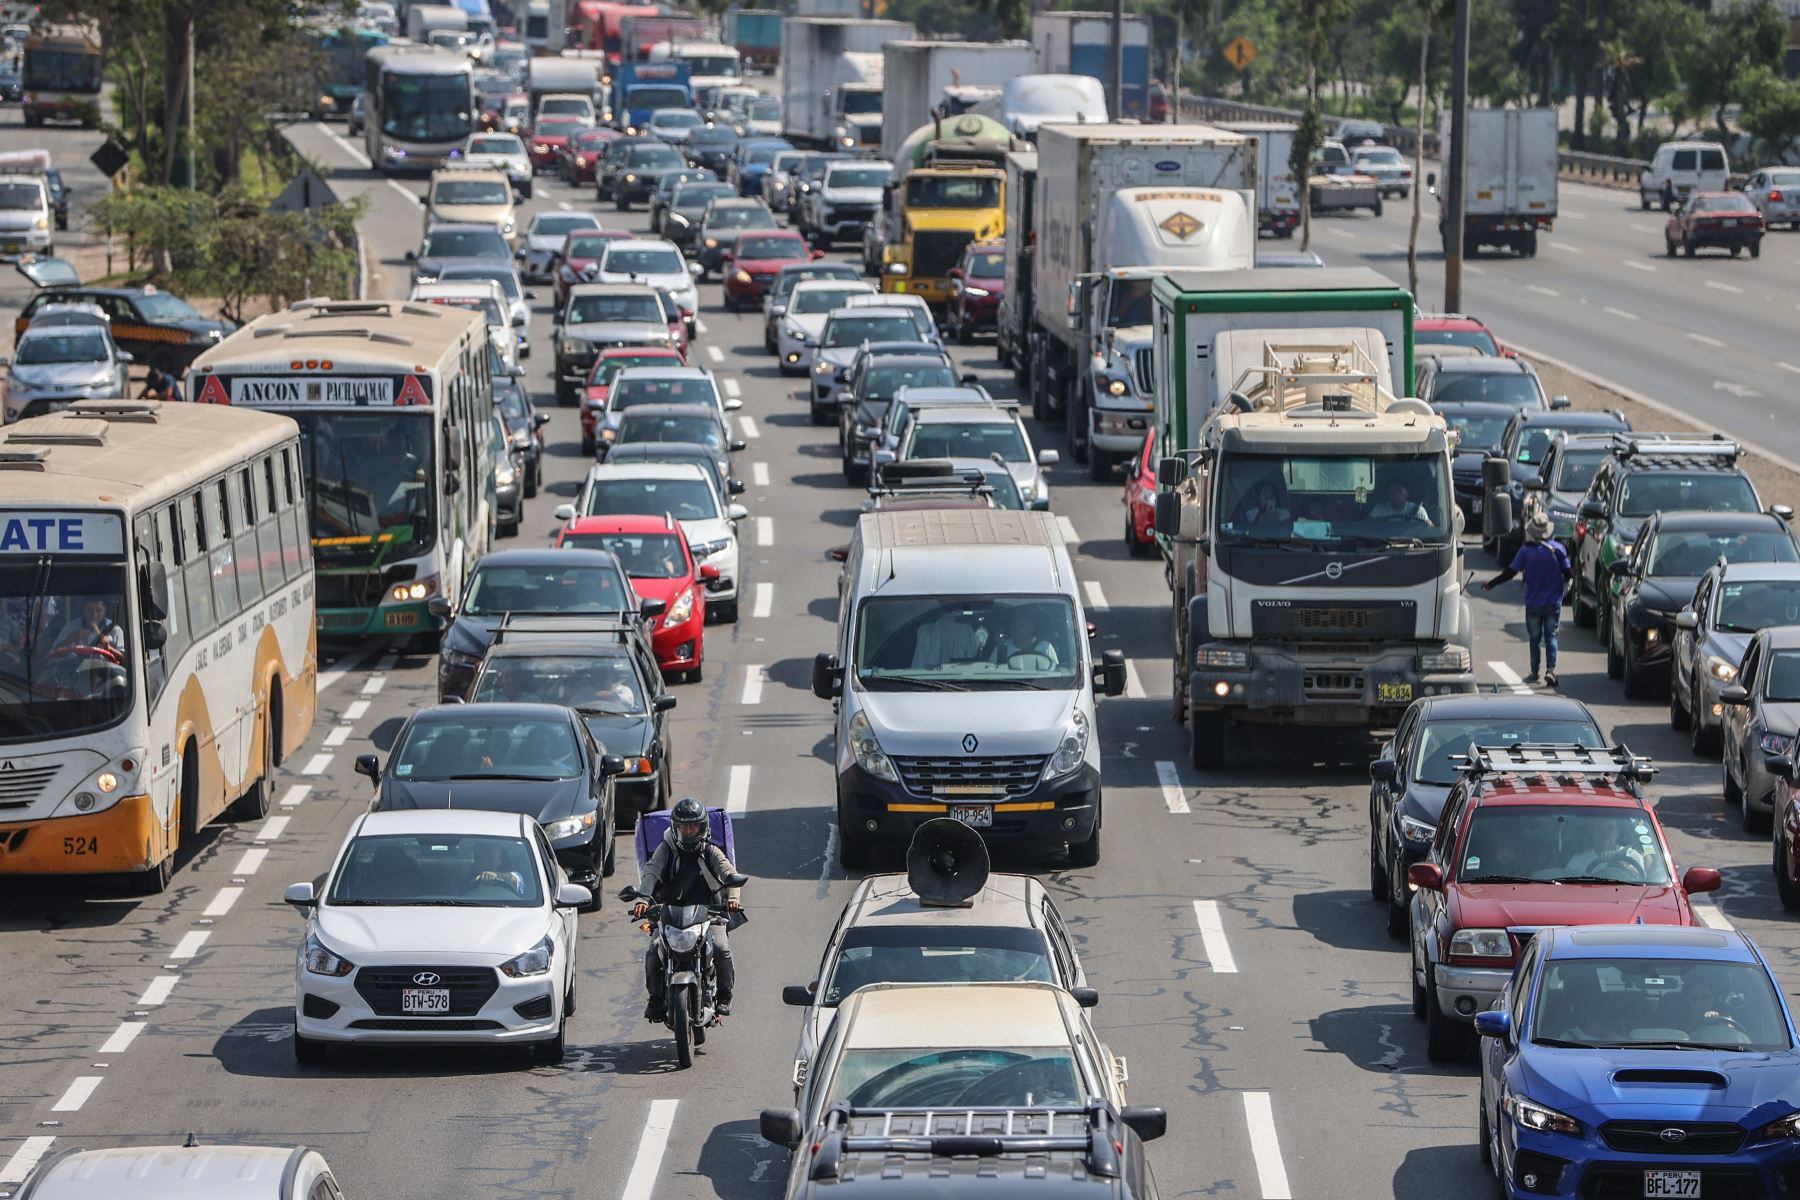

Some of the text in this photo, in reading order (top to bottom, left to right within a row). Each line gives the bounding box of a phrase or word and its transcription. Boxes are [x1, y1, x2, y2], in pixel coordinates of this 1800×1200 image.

[240, 382, 300, 401] ANCON
[327, 382, 389, 401] PACHACAMAC
[0, 519, 84, 550] ATE
[64, 837, 98, 855] 524
[404, 995, 448, 1009] BTW-578
[1647, 1179, 1699, 1194] BFL-177
